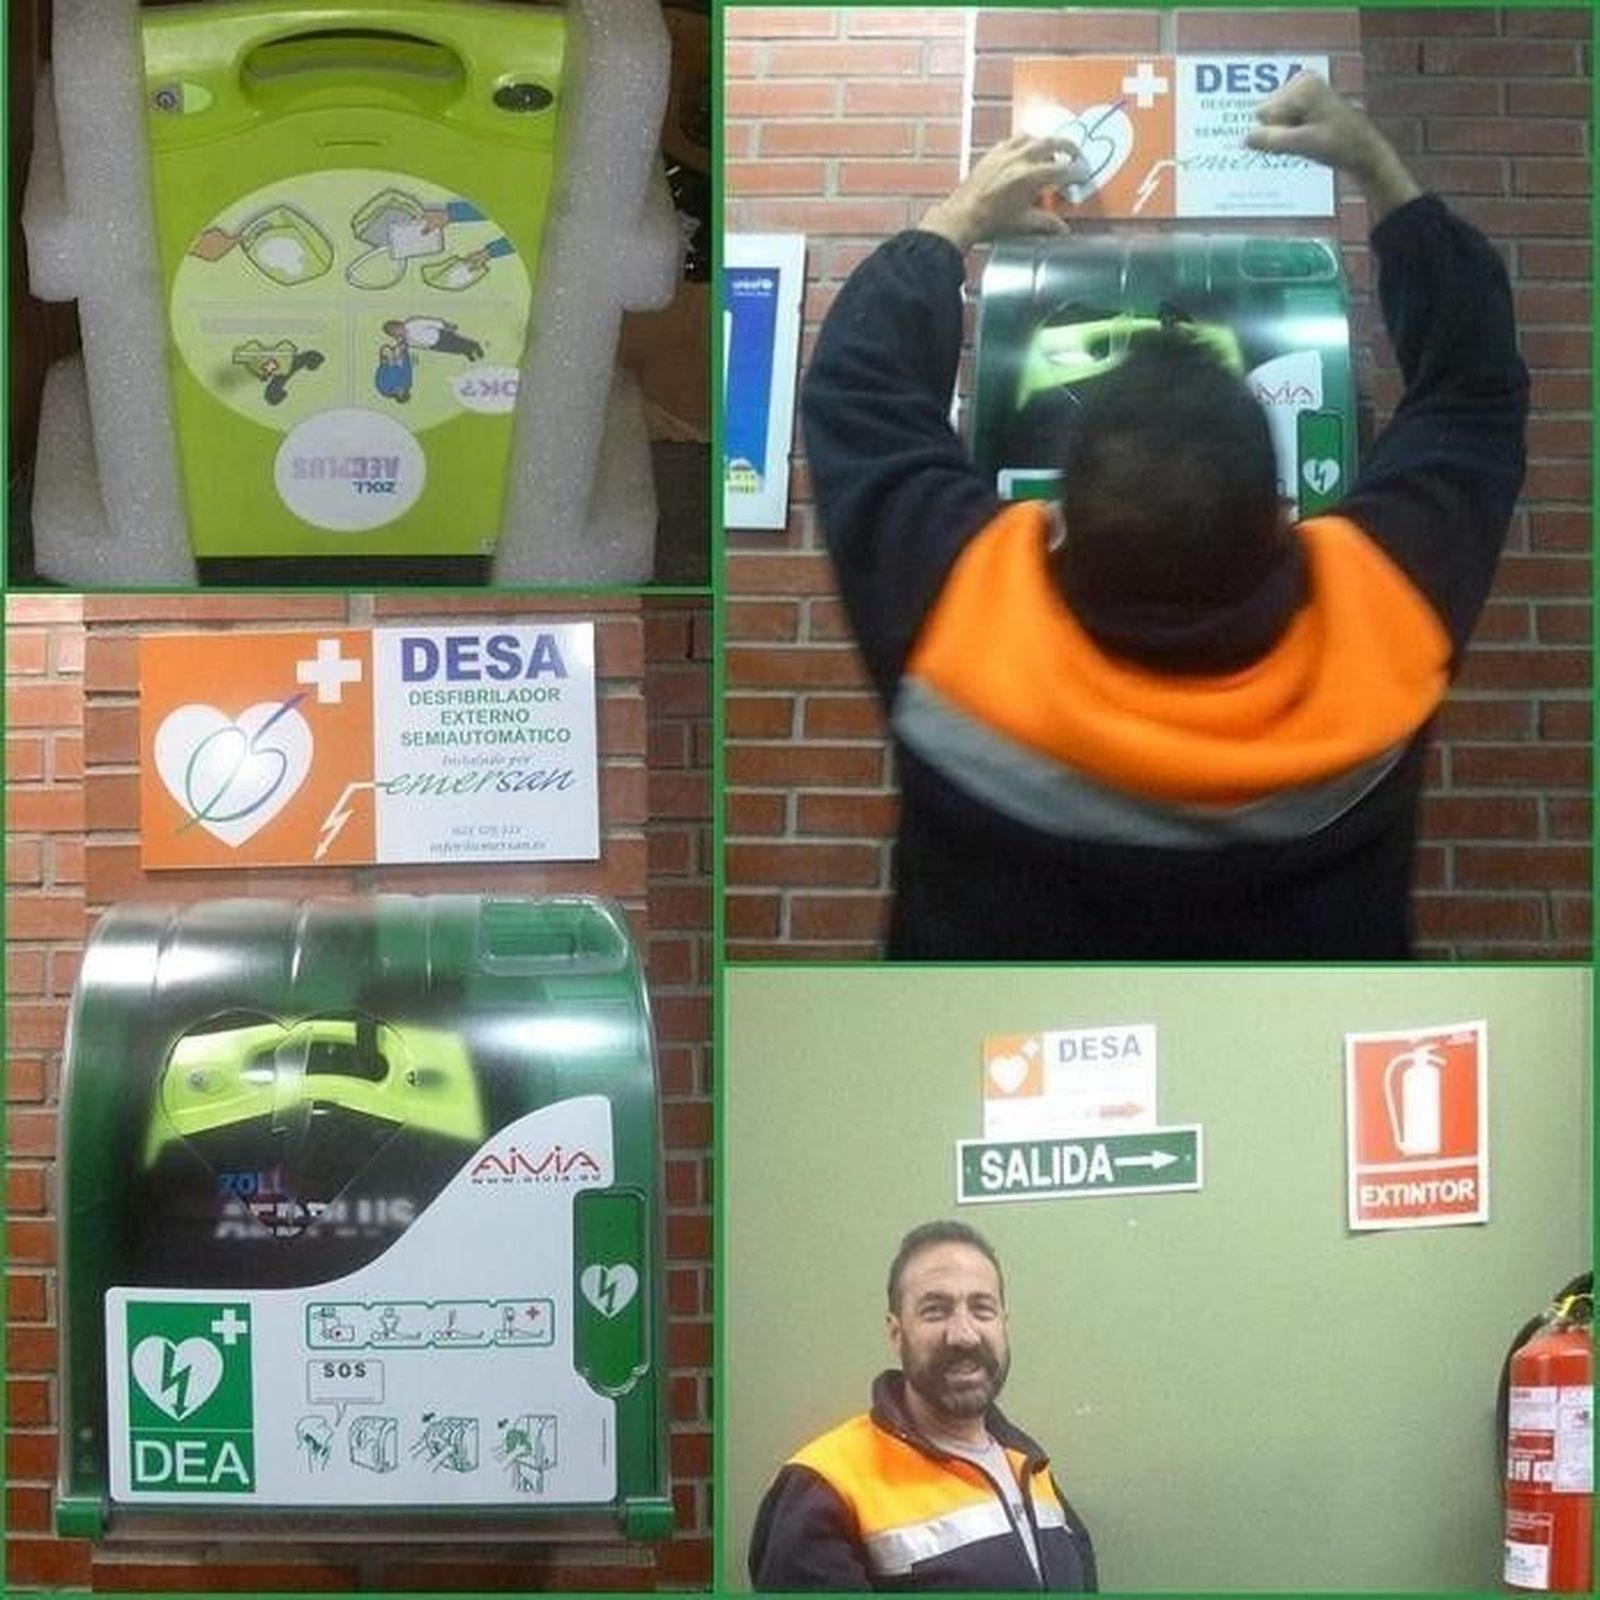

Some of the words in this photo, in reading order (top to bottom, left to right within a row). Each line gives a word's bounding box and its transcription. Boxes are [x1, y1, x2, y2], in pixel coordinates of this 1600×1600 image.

[401, 634, 568, 682] DESA
[408, 687, 562, 706] DESFIBRILADOR
[440, 708, 531, 726] EXTERNO
[380, 769, 576, 796] emersan
[1058, 1034, 1142, 1063] DESA
[979, 1144, 1115, 1189] SALIDA
[1360, 1178, 1476, 1208] EXTINTOR
[323, 1361, 367, 1379] SOS
[134, 1440, 250, 1484] DEA
